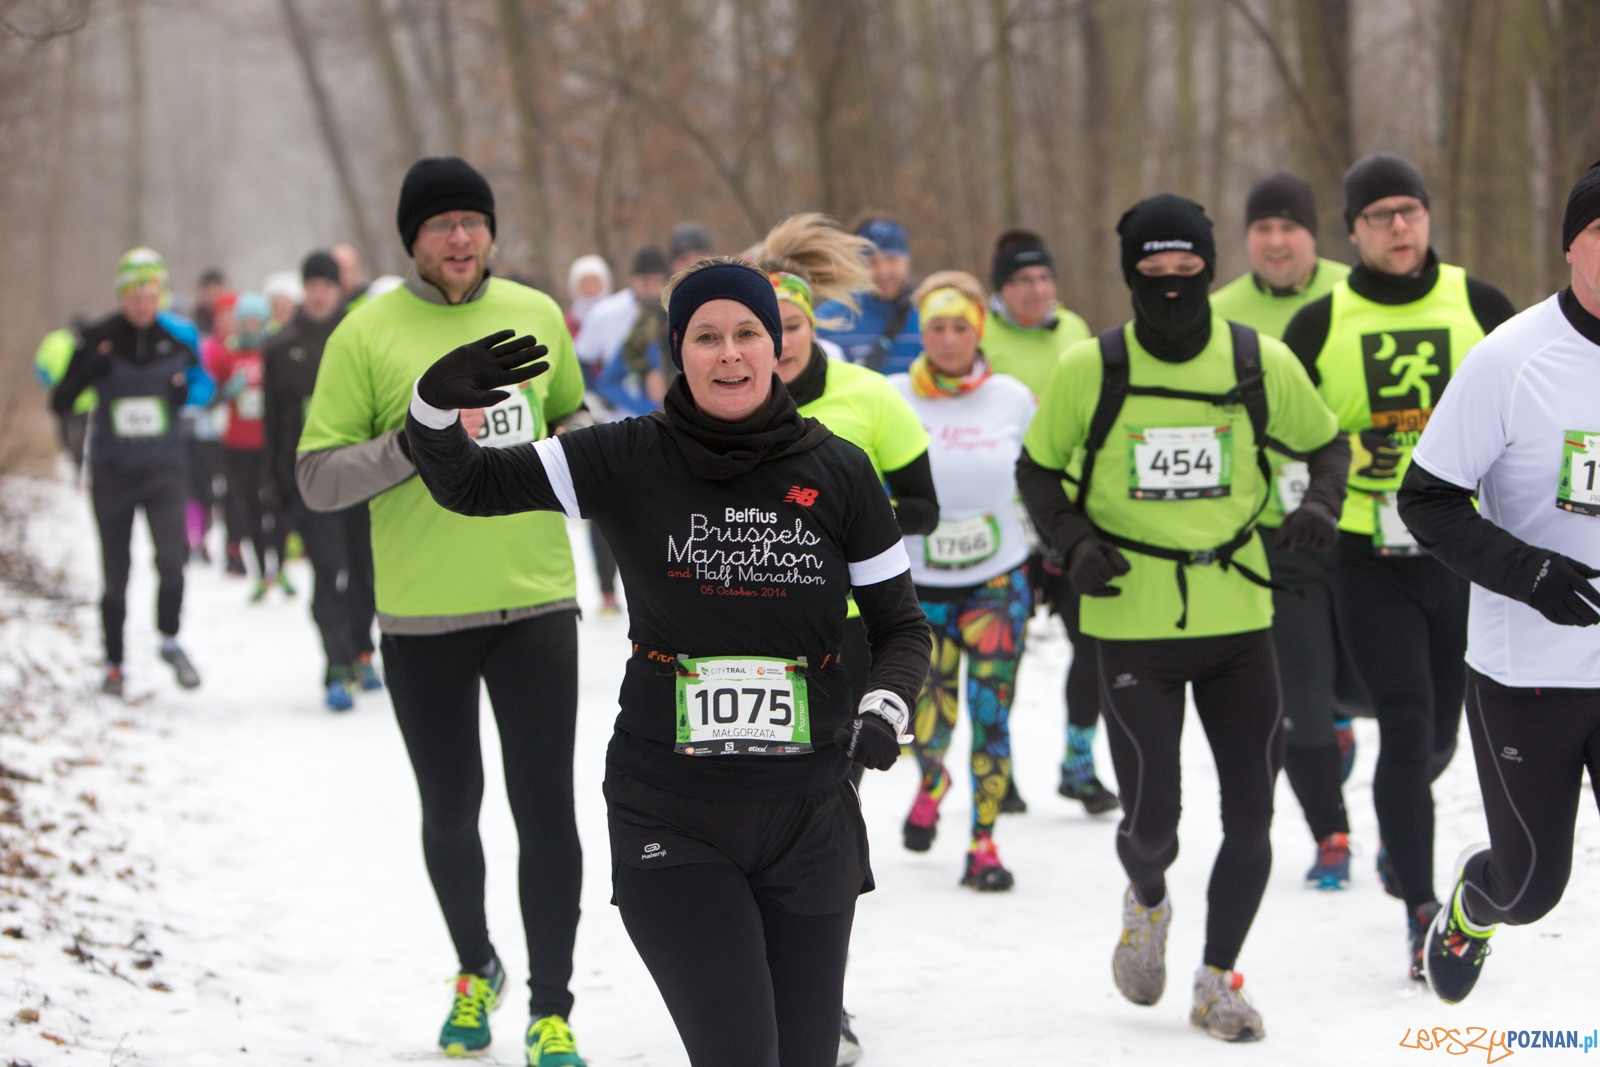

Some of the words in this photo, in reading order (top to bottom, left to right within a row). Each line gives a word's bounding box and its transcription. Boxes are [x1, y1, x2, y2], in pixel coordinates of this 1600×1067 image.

[1149, 448, 1213, 476] 454
[1583, 460, 1600, 491] 1
[690, 513, 821, 546] Brussels
[724, 507, 778, 524] Belfius
[667, 534, 824, 569] Marathon
[667, 566, 692, 579] and
[696, 563, 733, 588] Half
[738, 565, 826, 586] Marathon
[700, 585, 714, 596] 05
[716, 585, 758, 597] October
[761, 587, 787, 598] 2014
[695, 687, 792, 726] 1075
[712, 728, 776, 739] MAŁGORZATA
